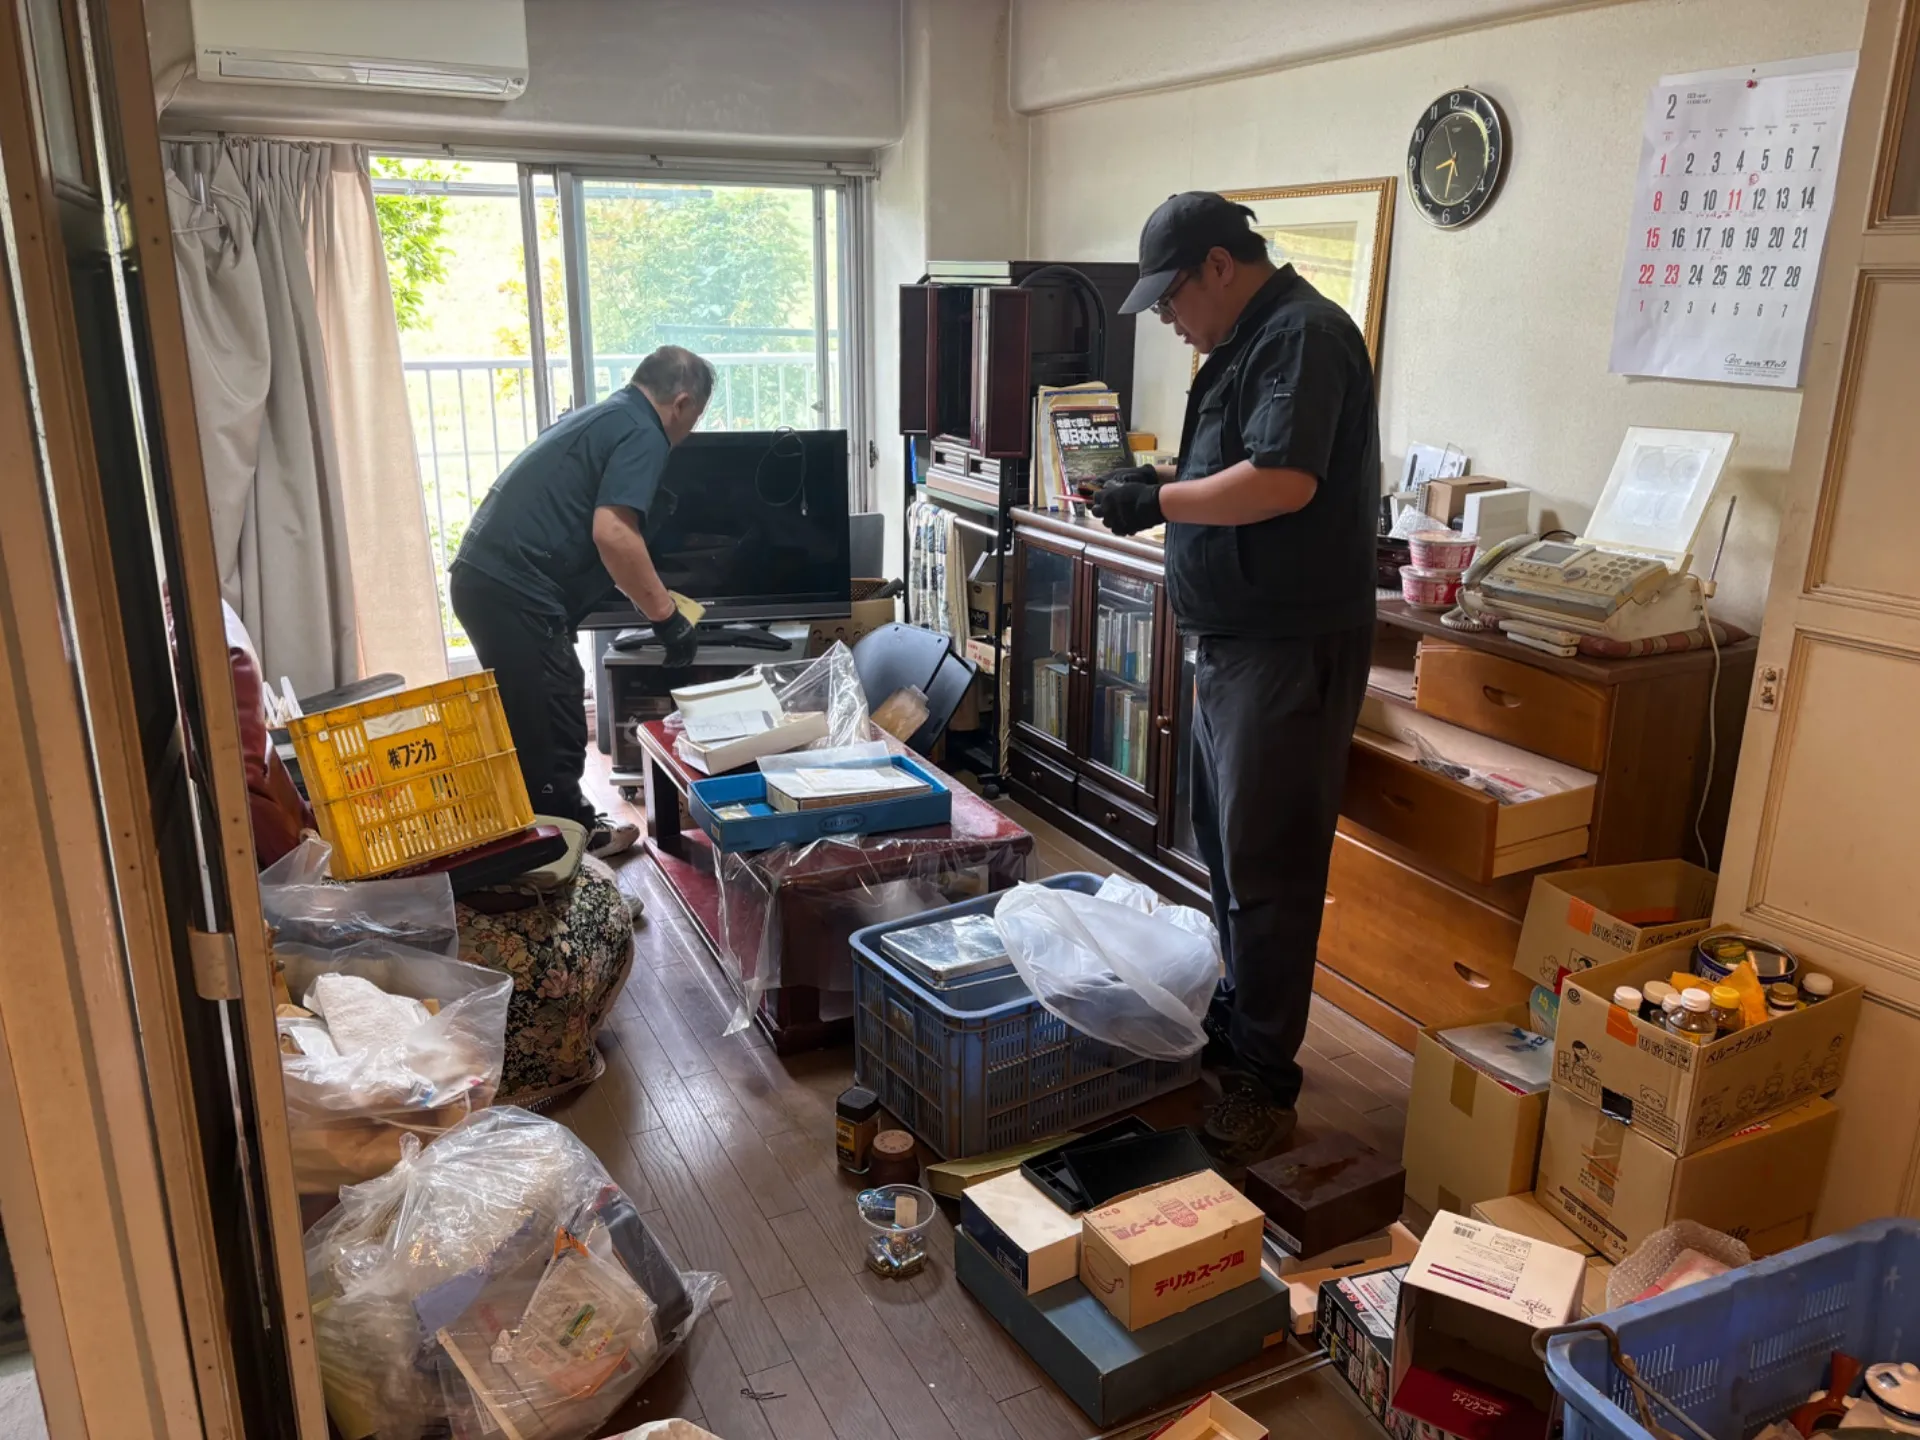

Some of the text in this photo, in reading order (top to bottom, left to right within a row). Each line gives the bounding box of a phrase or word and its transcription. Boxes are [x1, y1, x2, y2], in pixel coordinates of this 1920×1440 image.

[1450, 94, 1460, 109] 12
[1665, 93, 1677, 119] 2
[1429, 105, 1438, 120] 11
[1484, 117, 1494, 134] 2
[1415, 127, 1425, 143] 10
[1488, 147, 1495, 162] 3
[1660, 146, 1819, 174] 1 2 3 4 5 6 7
[1409, 155, 1416, 171] 9
[1477, 179, 1485, 192] 4
[1653, 186, 1815, 211] 8 9 10 11 12 13 14
[1424, 204, 1432, 213] 7
[1442, 208, 1450, 223] 6
[1462, 200, 1471, 215] 5
[1646, 227, 1808, 248] 15 16 17 18 19 20 21
[1638, 264, 1801, 287] 22 23 24 25 26 27 28
[1639, 300, 1788, 318] 1 2 3 4 5 6 7
[1058, 426, 1120, 445] 東日本大震災
[1154, 1250, 1245, 1297] デリカスープ皿
